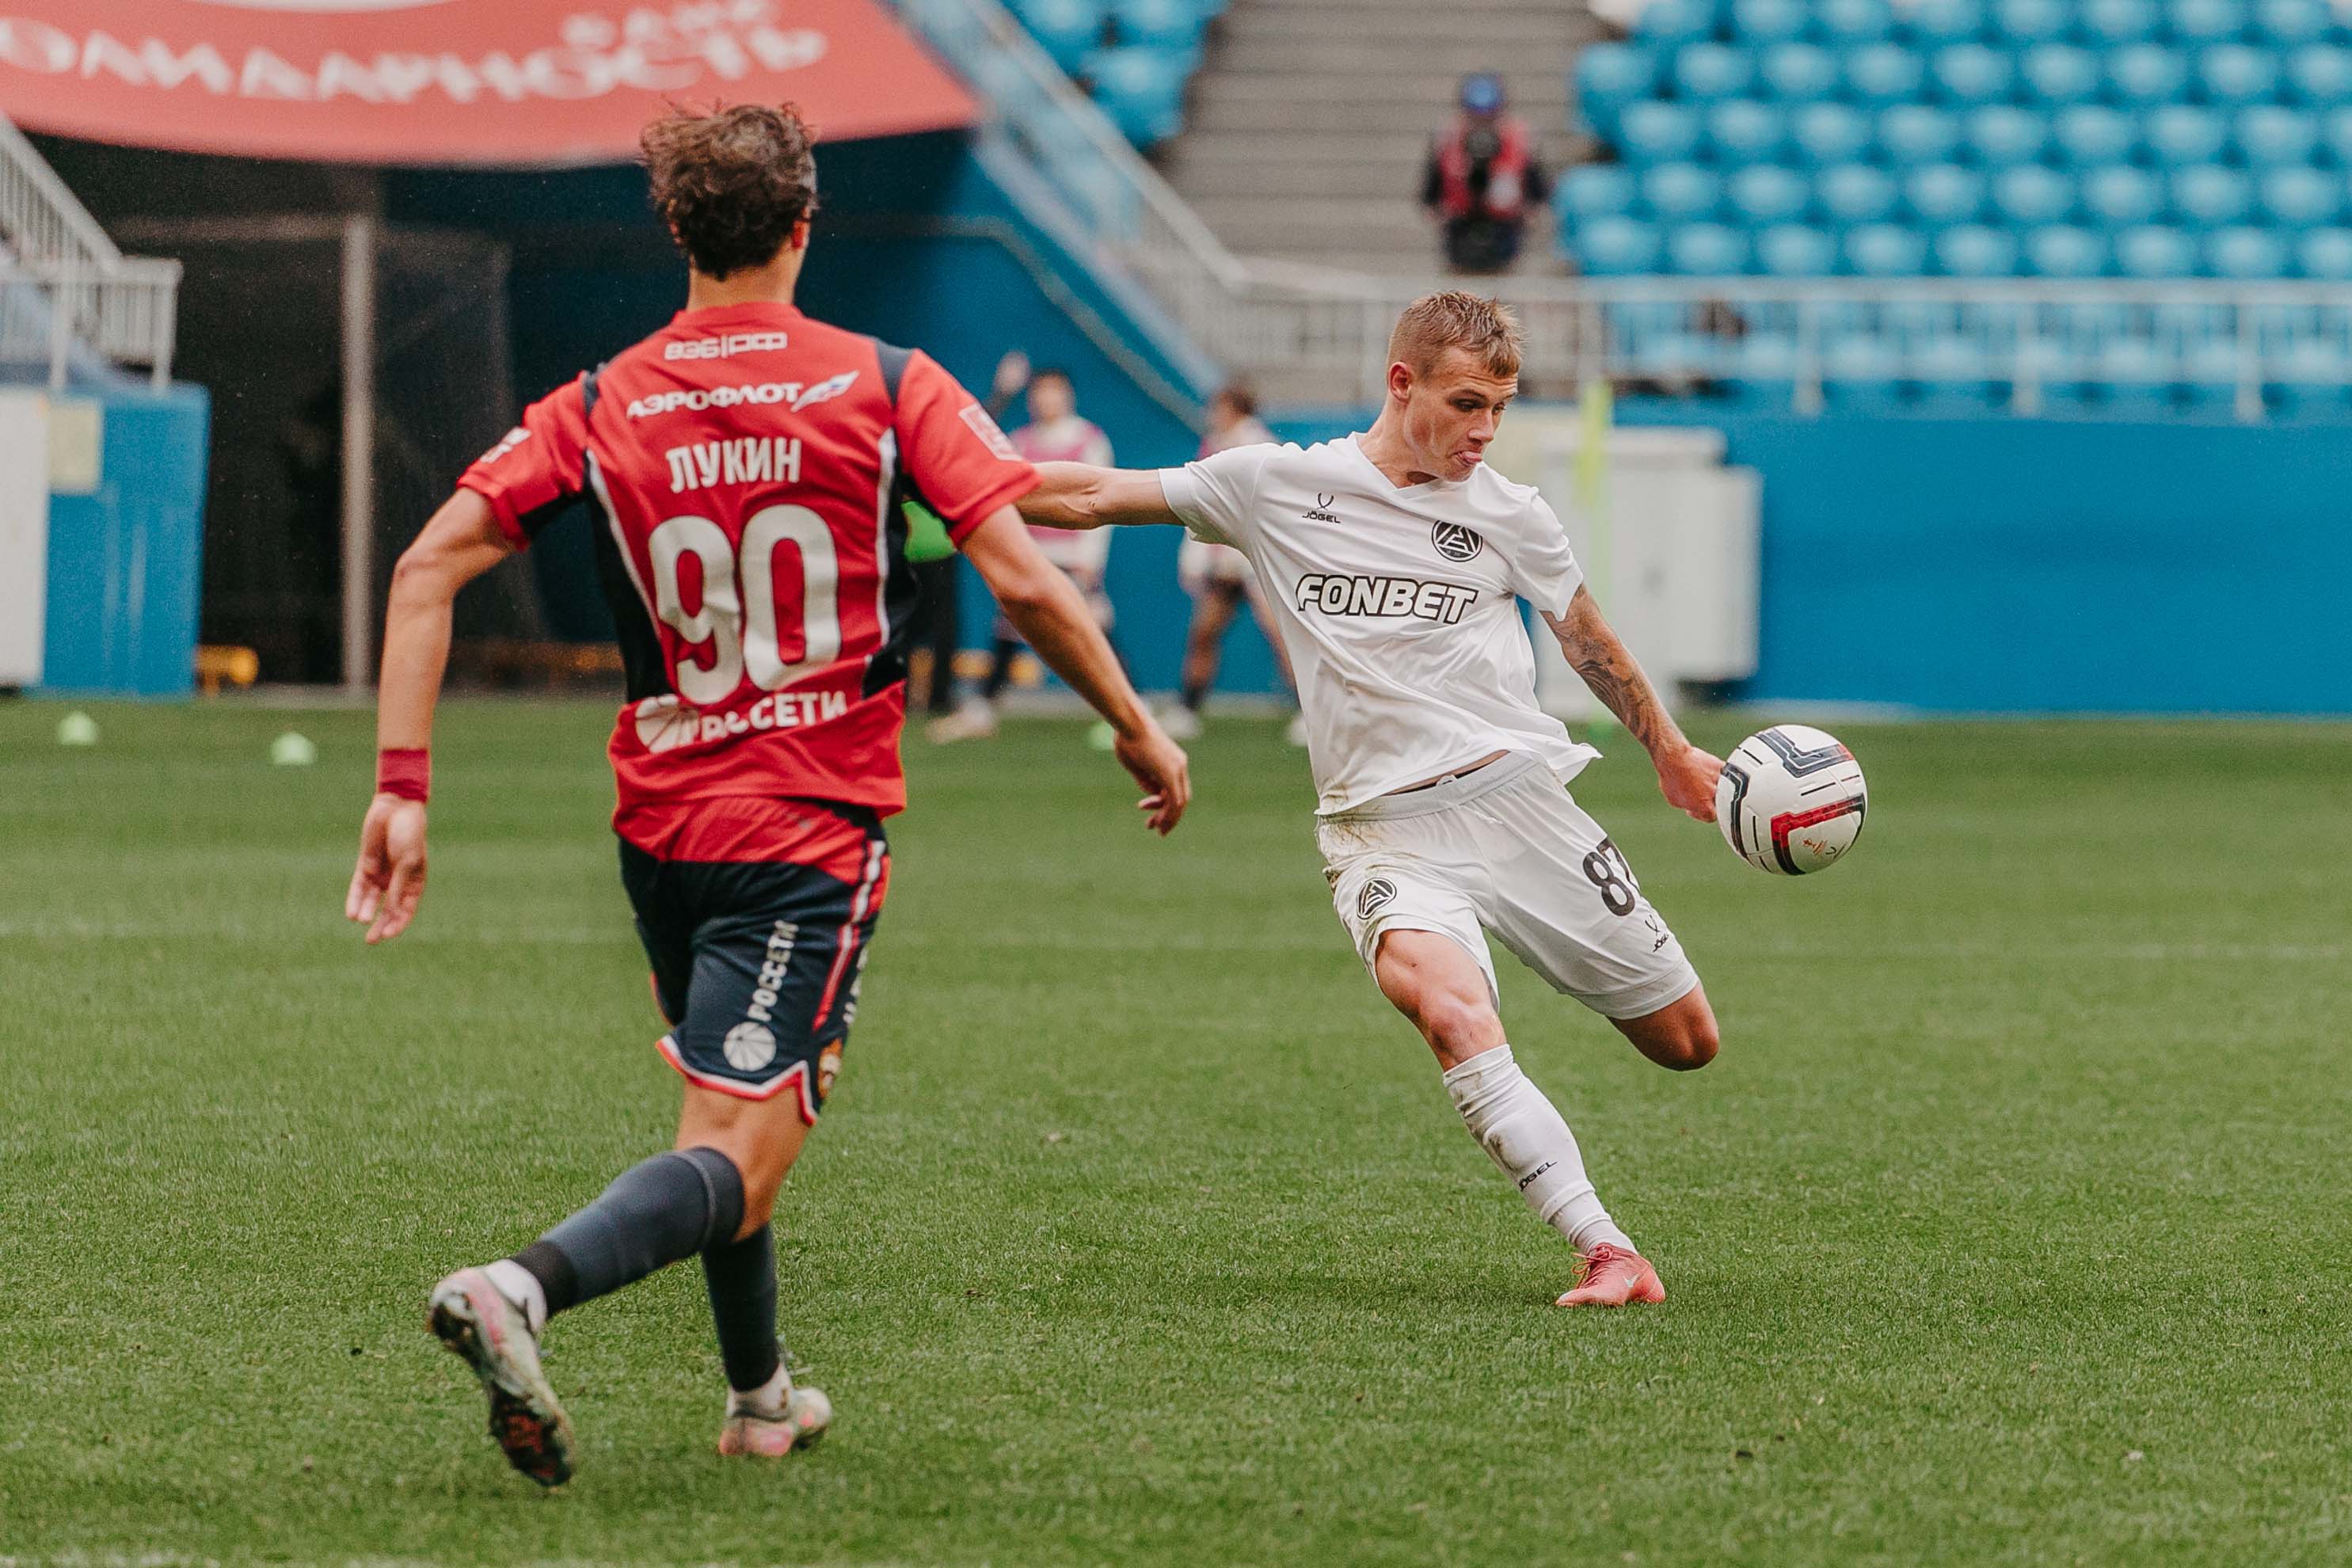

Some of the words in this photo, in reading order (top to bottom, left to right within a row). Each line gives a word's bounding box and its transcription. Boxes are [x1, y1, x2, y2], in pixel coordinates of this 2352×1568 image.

[626, 382, 804, 419] АЭРОФЛОТ
[665, 437, 801, 493] ЛУКИН
[1301, 510, 1342, 524] JÖGEL
[648, 503, 842, 705] 90
[1296, 573, 1479, 624] FONBET
[748, 919, 799, 1022] РОССЕТИ
